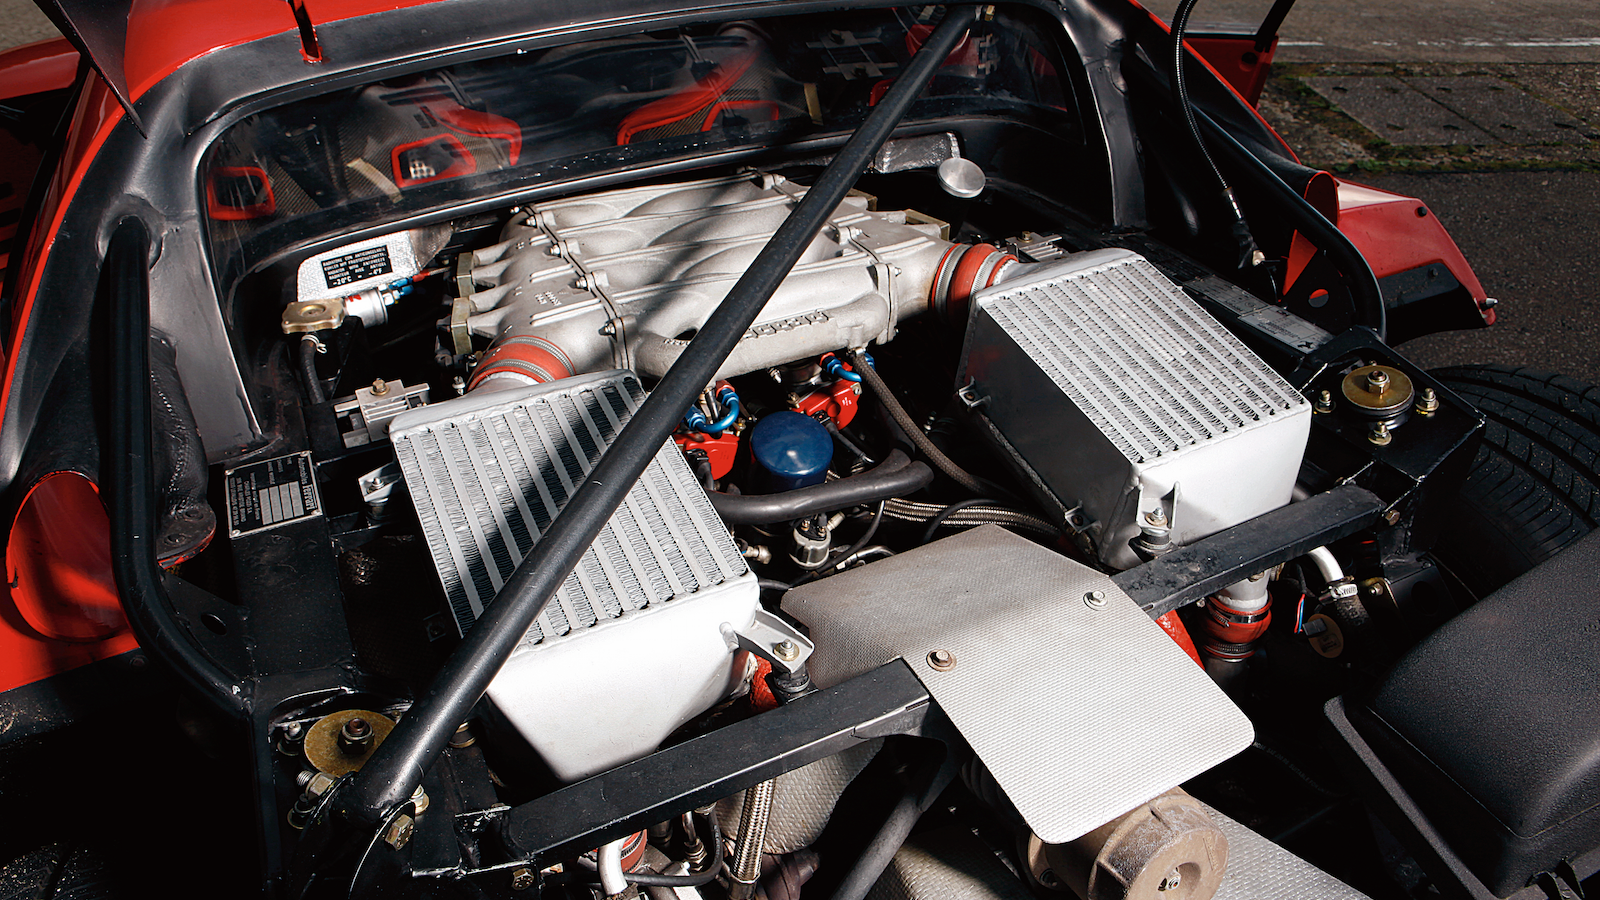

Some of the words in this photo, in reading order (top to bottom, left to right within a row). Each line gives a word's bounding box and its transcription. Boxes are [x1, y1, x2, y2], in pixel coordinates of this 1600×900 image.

[332, 276, 352, 285] -20°C
[298, 458, 308, 484] Automobiles
[302, 484, 317, 510] Ferrari
[1289, 764, 1310, 782] SUITABLE
